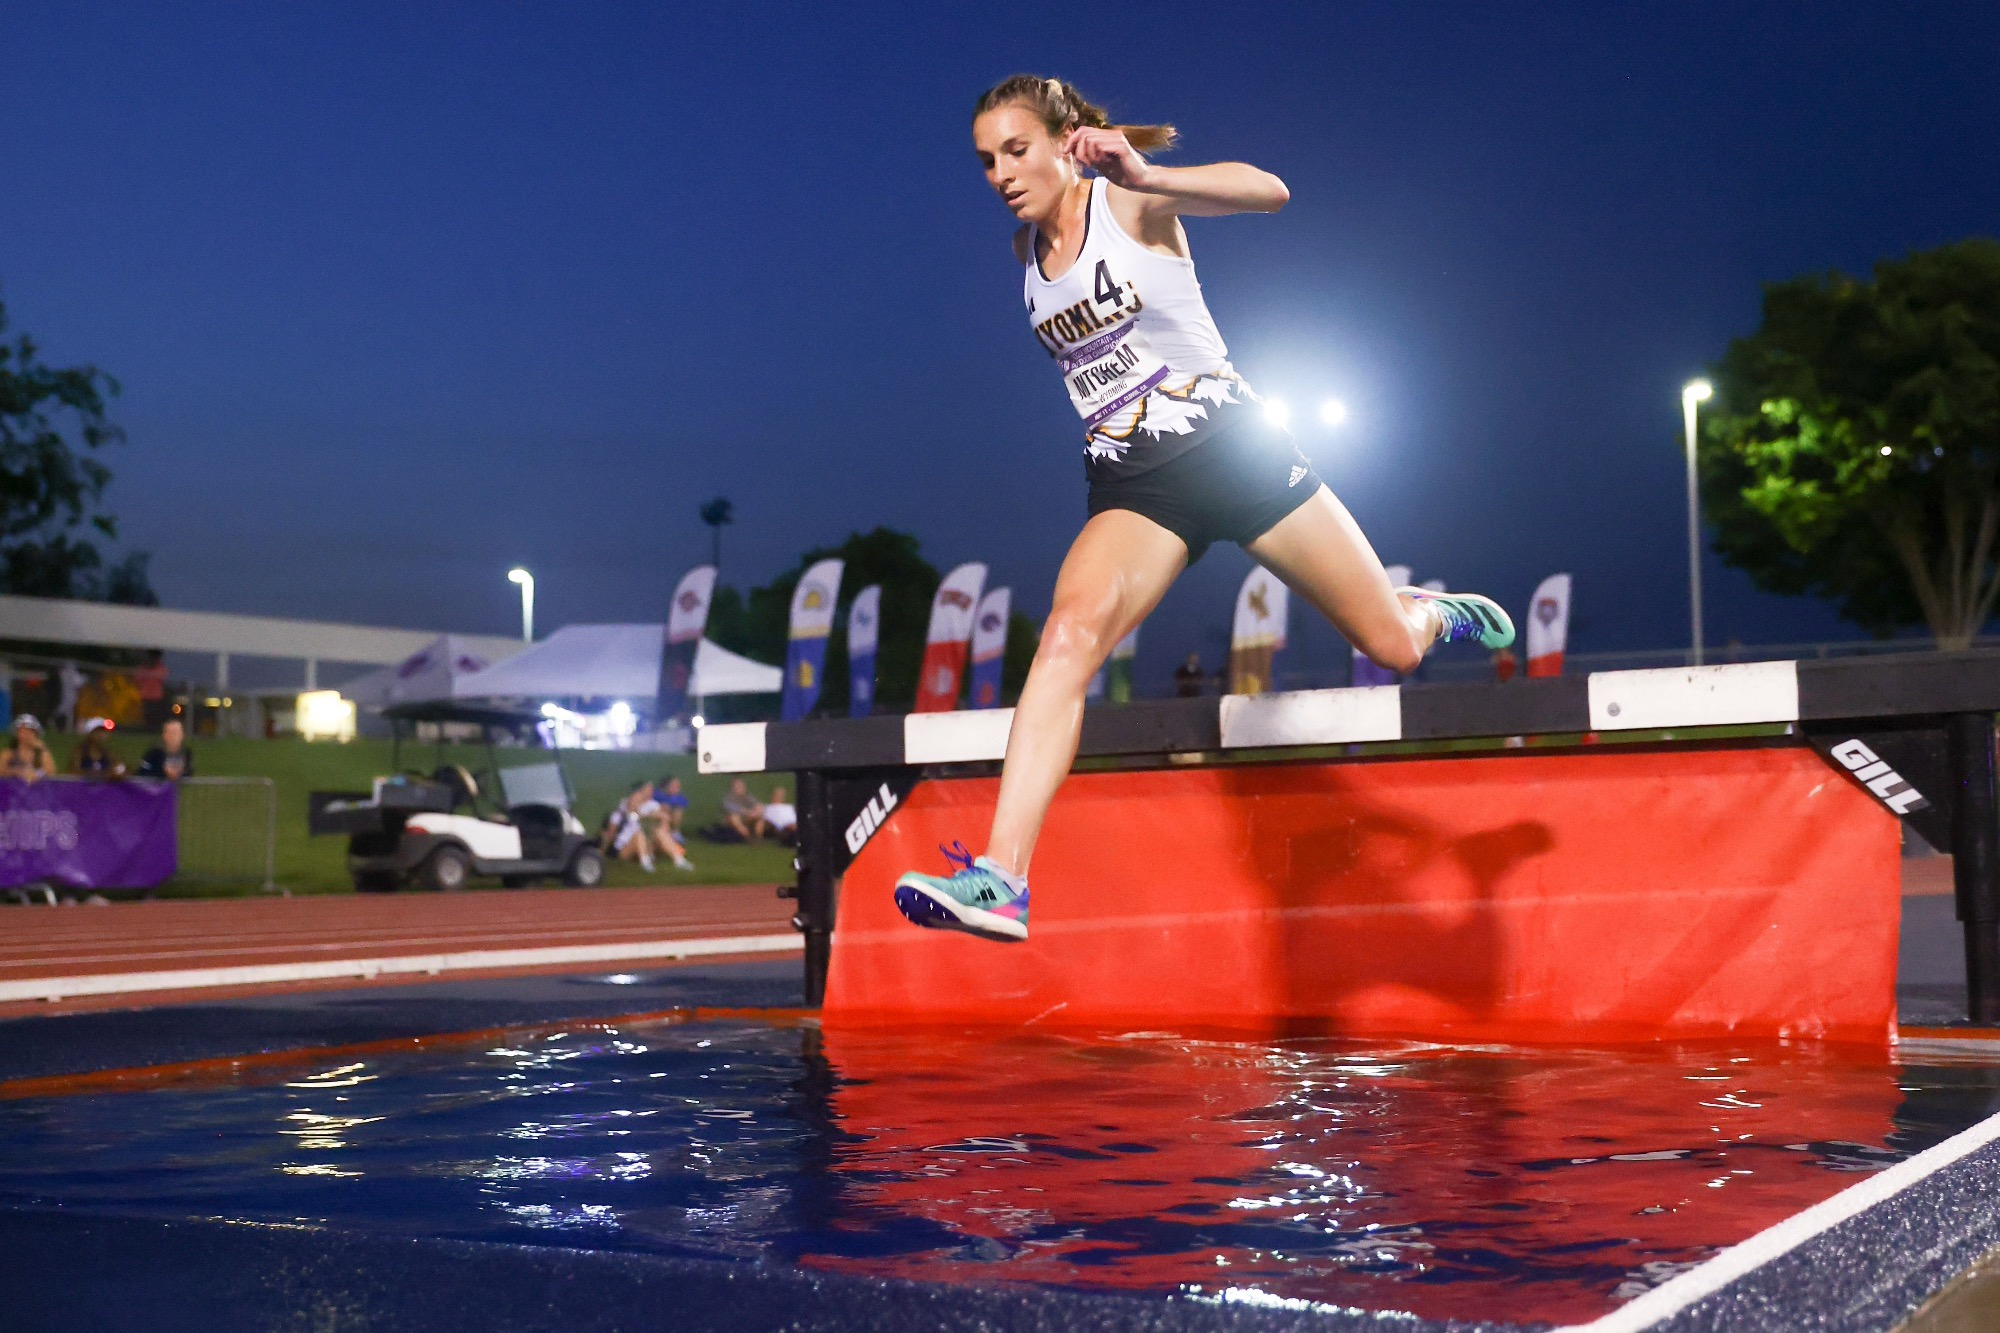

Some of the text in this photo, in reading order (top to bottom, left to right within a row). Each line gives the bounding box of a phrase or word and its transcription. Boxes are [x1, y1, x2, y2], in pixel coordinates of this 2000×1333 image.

[1034, 280, 1143, 359] YOMI
[1094, 259, 1124, 308] 4
[1099, 380, 1128, 403] WYOMING
[1831, 739, 1923, 814] GILL
[845, 782, 898, 854] GILL
